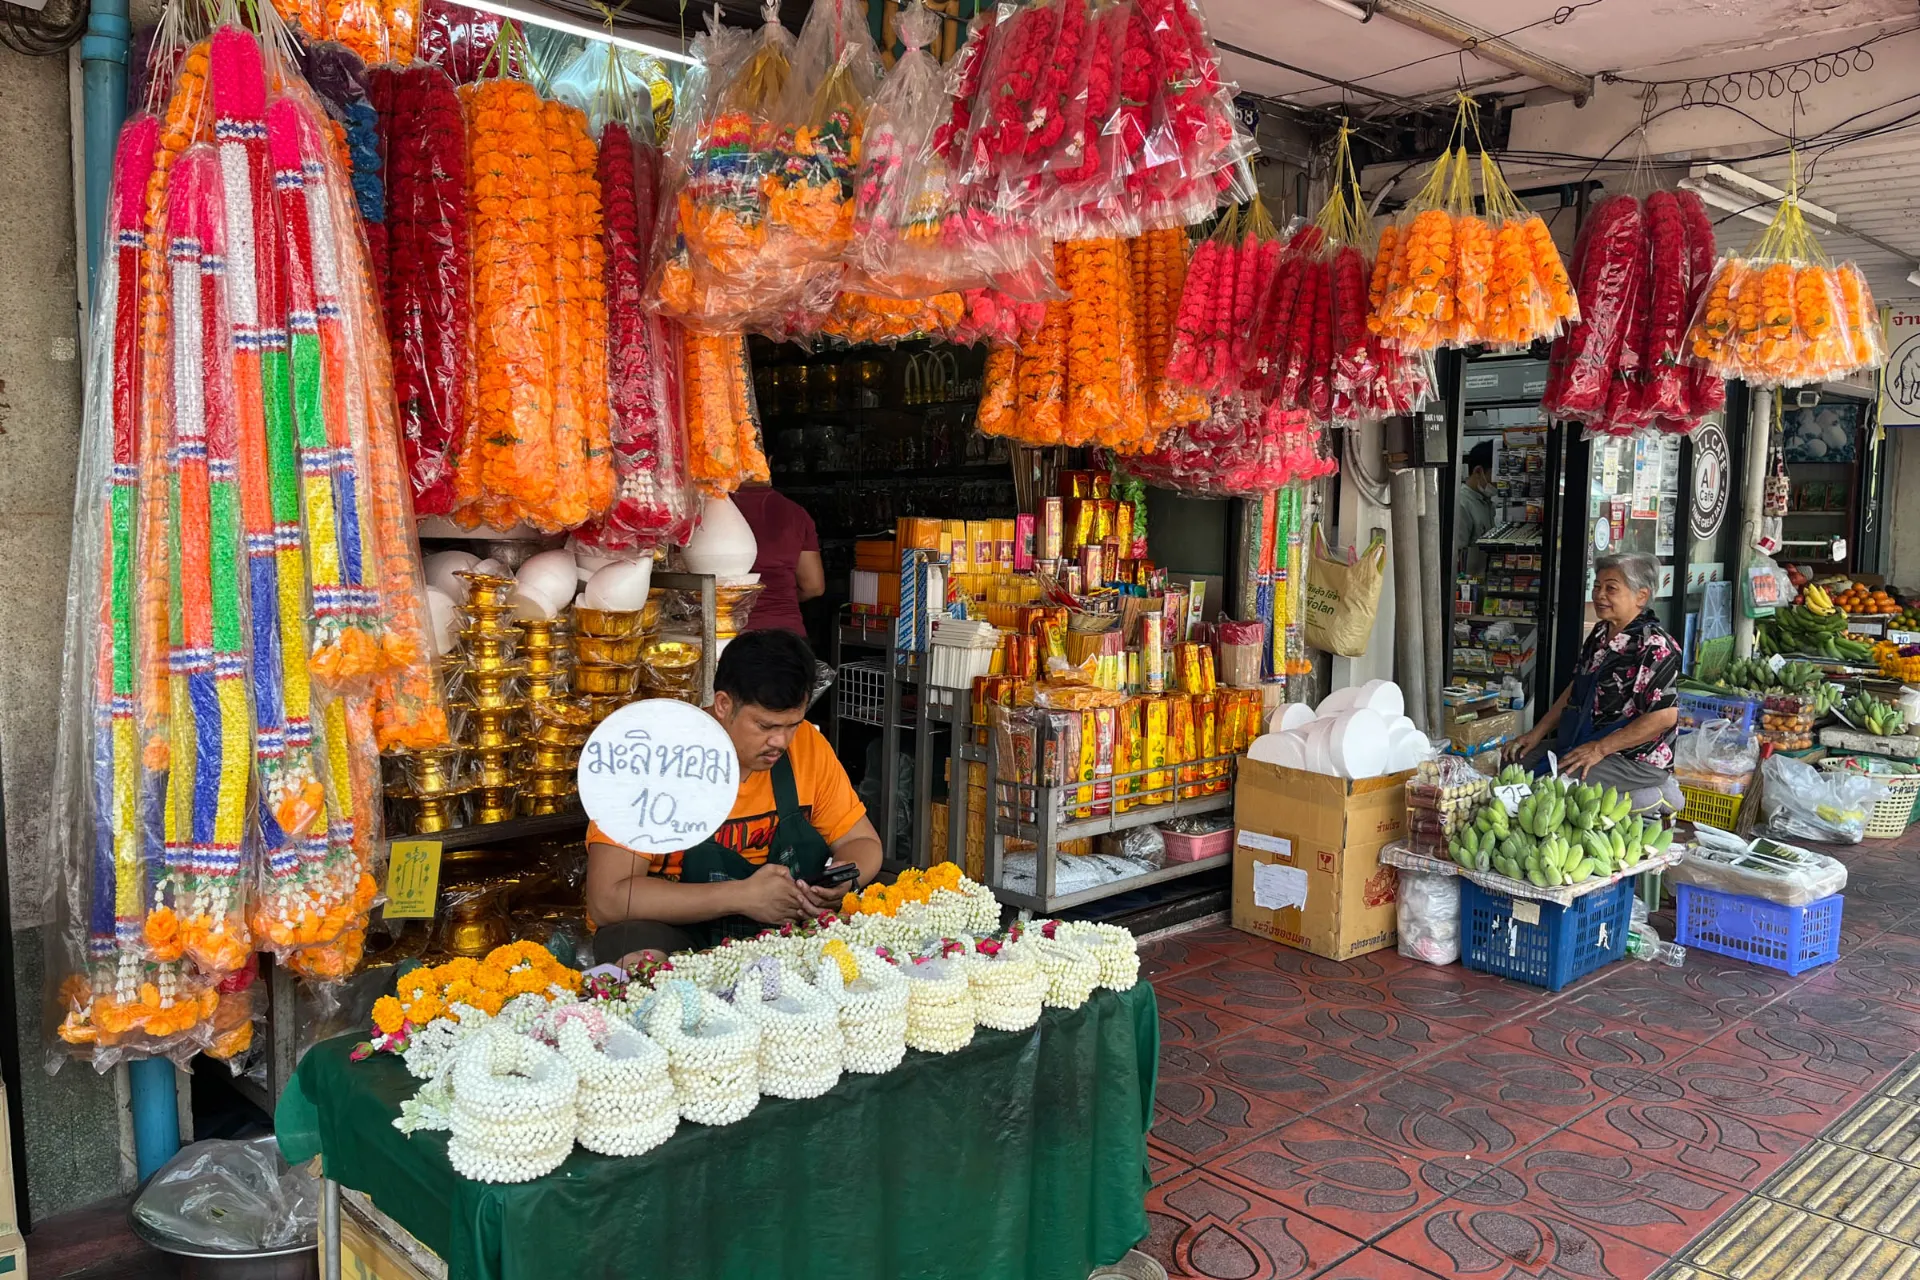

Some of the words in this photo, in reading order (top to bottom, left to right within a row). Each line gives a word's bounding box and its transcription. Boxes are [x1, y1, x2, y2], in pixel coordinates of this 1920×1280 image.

[1711, 434, 1727, 472] CAFE
[1700, 463, 1716, 488] All
[1699, 489, 1714, 503] Cafe
[587, 729, 731, 784] มะลิหอม
[631, 787, 678, 828] 10
[1252, 920, 1312, 947] ระวังของแตก
